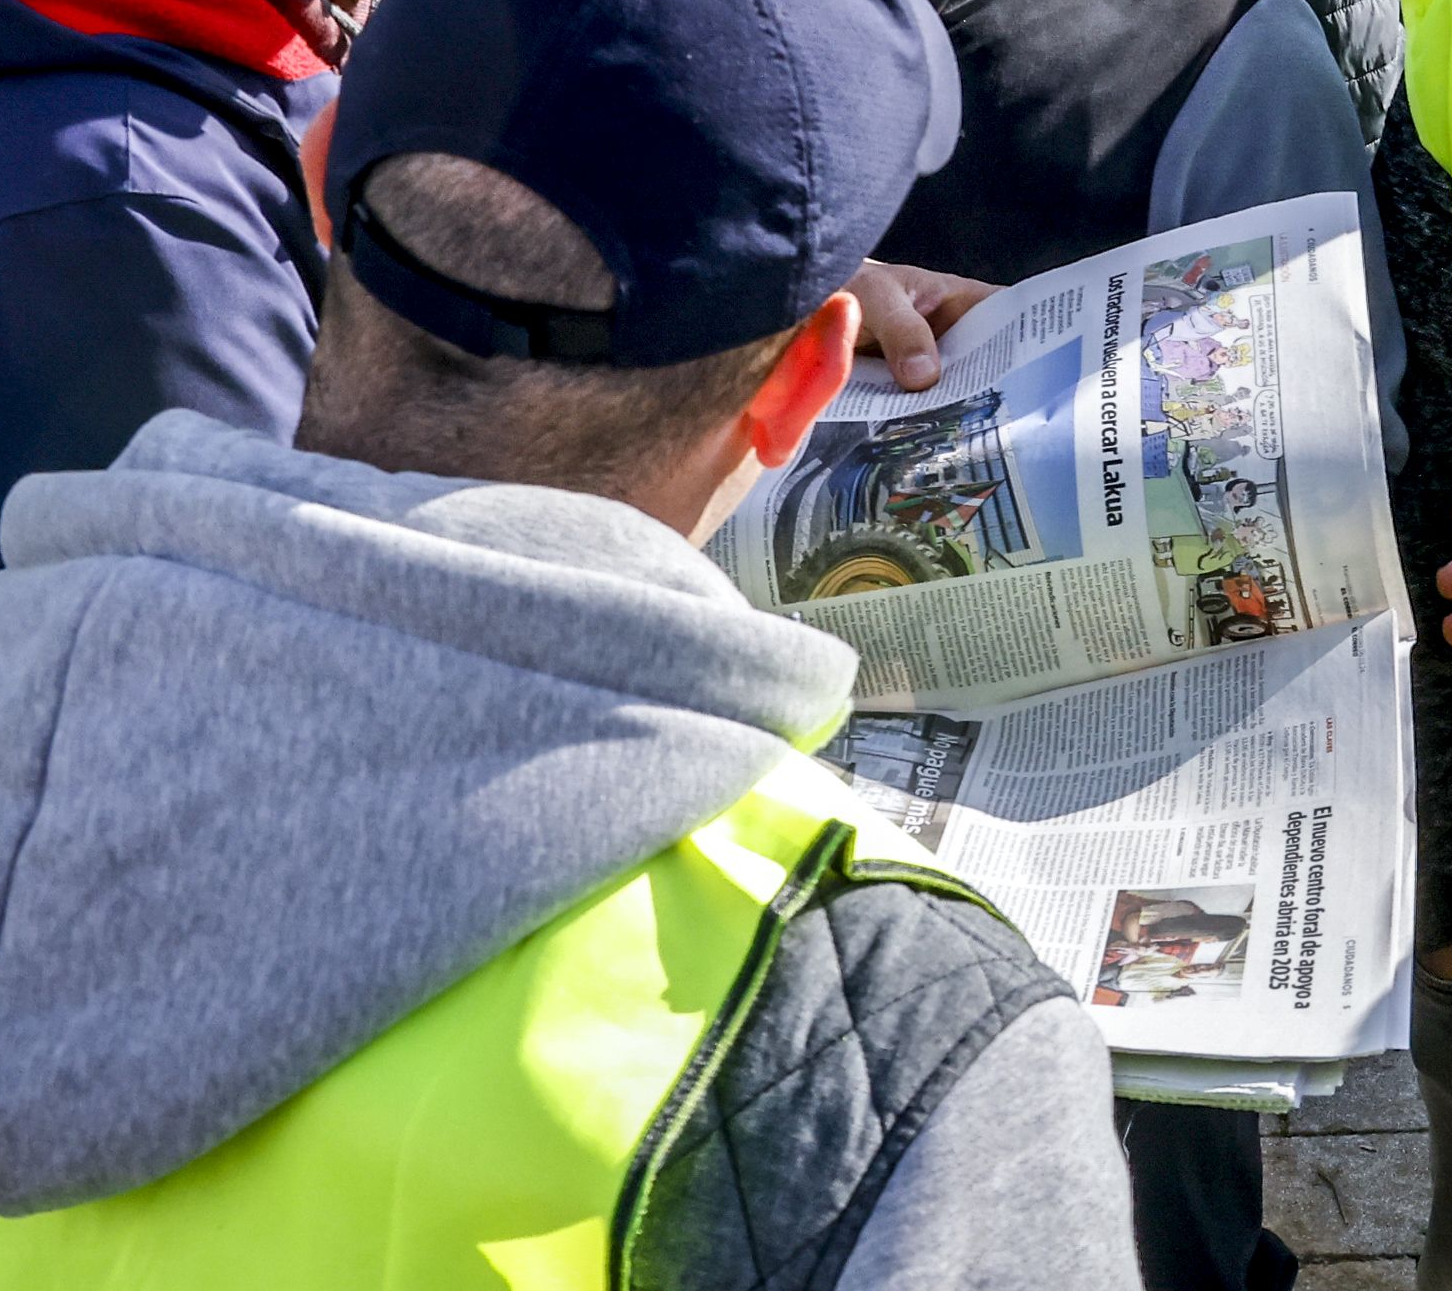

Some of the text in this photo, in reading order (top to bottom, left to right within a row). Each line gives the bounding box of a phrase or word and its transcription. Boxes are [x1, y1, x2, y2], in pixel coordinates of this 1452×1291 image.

[1307, 238, 1318, 281] CIUDADANOS
[1101, 272, 1127, 526] Los tractores vuelven a cercar Lakua
[905, 733, 959, 835] No pague más
[1313, 806, 1332, 819] El
[1310, 822, 1329, 862] nuevo
[1269, 812, 1307, 990] dependientes abrirá en 2025
[1306, 865, 1326, 905] centro
[1302, 908, 1325, 938] foral
[1300, 940, 1321, 956] de
[1342, 940, 1356, 995] CIUDADANOS
[1292, 960, 1314, 999] apoyo
